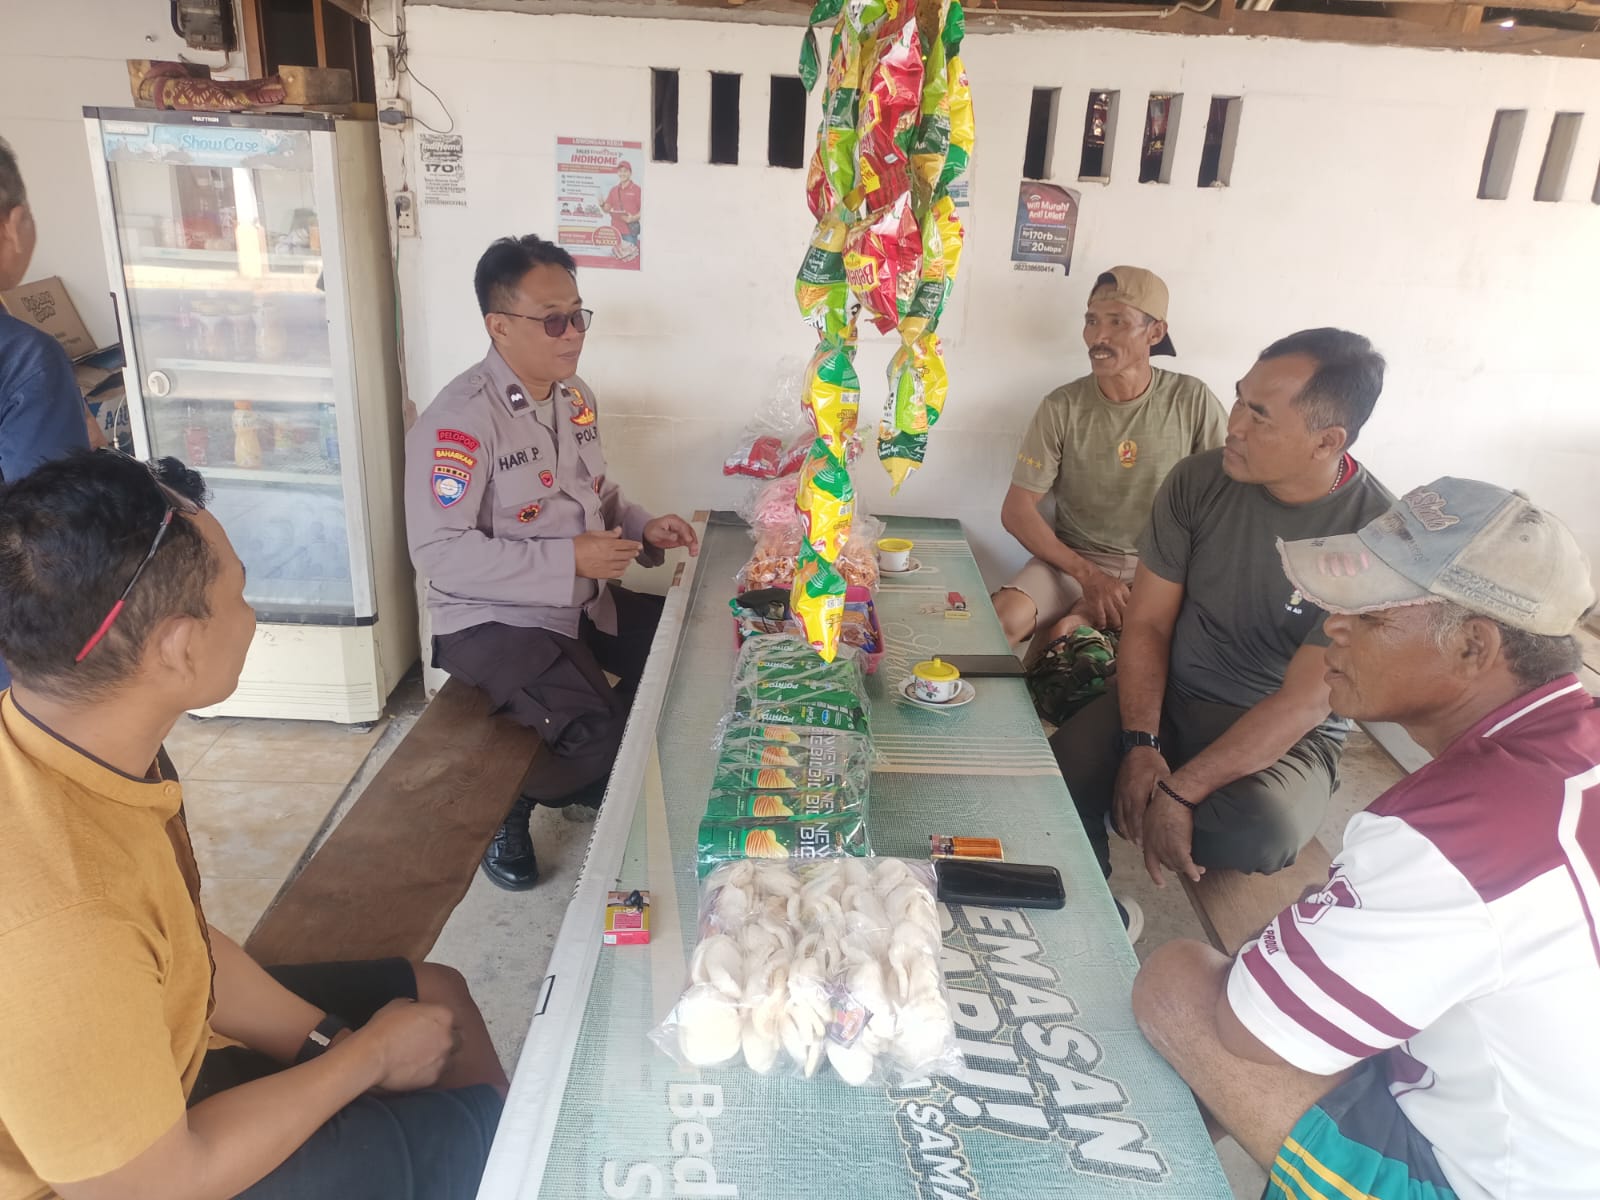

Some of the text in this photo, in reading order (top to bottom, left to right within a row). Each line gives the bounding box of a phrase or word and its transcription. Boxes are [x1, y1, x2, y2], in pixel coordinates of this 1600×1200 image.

[570, 154, 618, 166] INDIHOME
[439, 431, 476, 450] PELOPOR
[499, 451, 529, 471] HARI
[1263, 929, 1280, 956] PROUD
[961, 904, 1161, 1173] EMASAN
[667, 1083, 738, 1196] Bed
